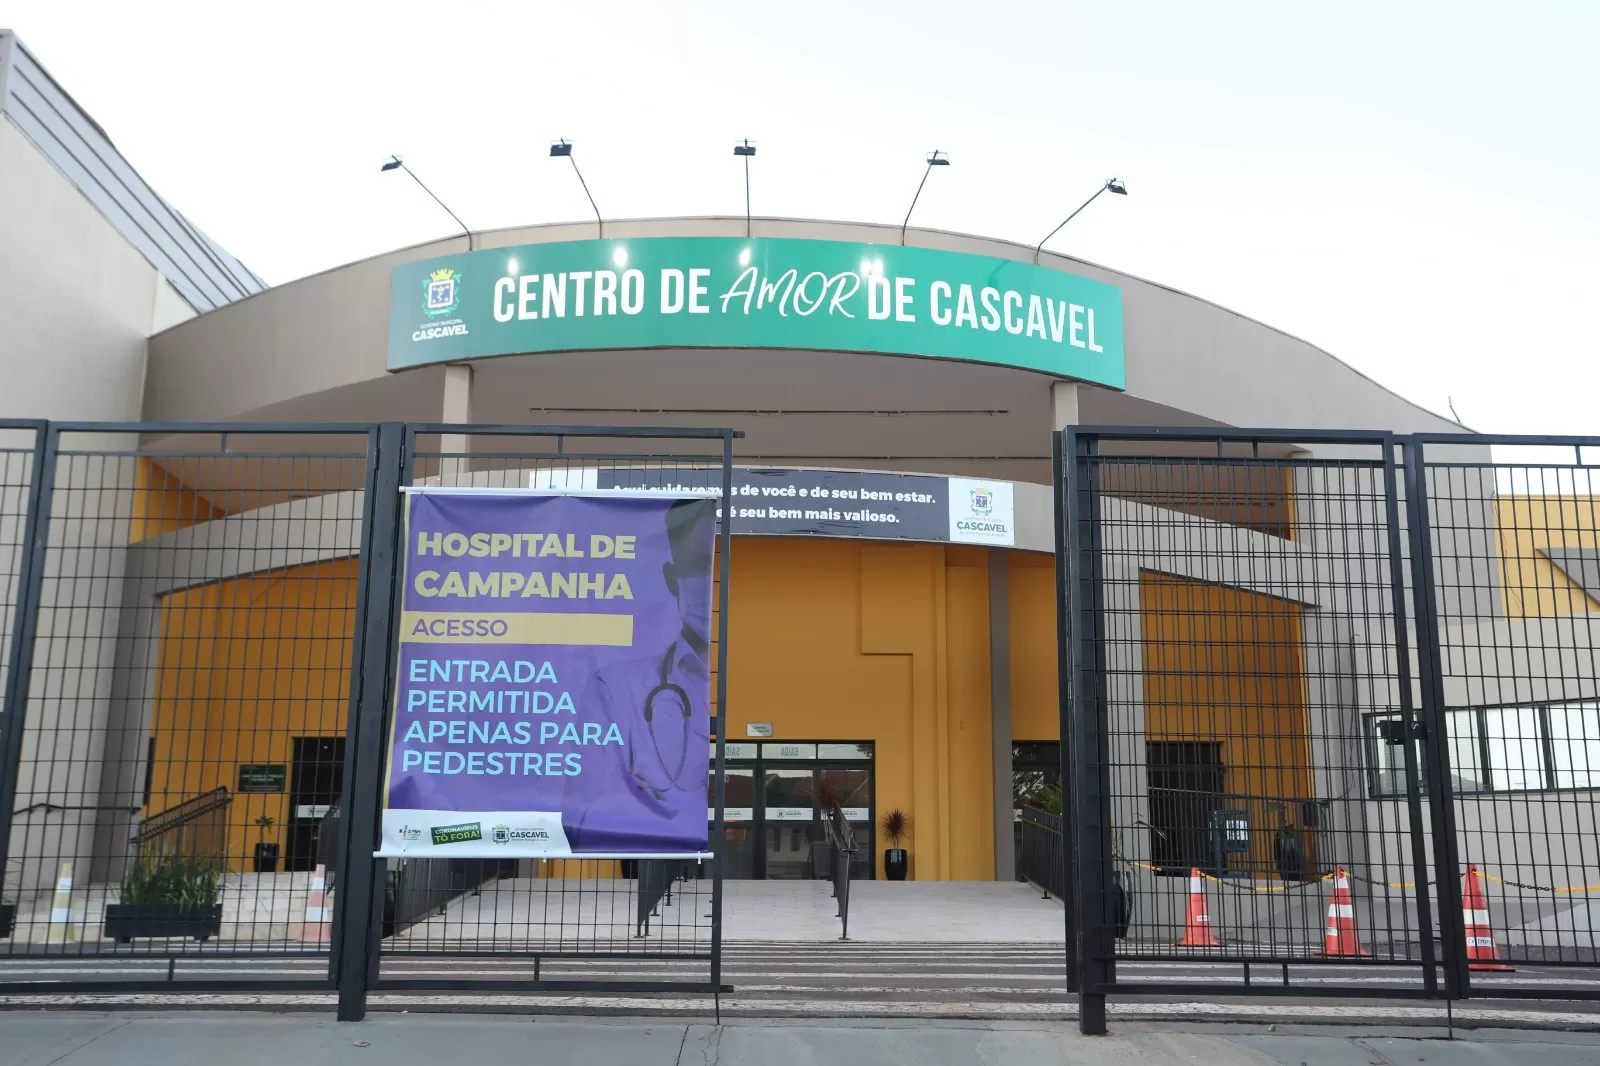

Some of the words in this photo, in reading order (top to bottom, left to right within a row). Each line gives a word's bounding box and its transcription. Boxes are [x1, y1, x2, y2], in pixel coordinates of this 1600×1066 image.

[493, 269, 645, 323] CENTRO
[660, 268, 711, 314] DE
[867, 275, 916, 323] DE
[930, 280, 1104, 353] CASCAVEL
[412, 324, 469, 341] CASCAVEL
[740, 485, 759, 496] de
[761, 485, 797, 497] você
[799, 488, 808, 497] e
[810, 486, 829, 498] de
[831, 489, 857, 500] seu
[860, 488, 893, 501] bem
[895, 491, 936, 504] estar.
[739, 508, 766, 518] seu
[769, 507, 802, 519] bem
[805, 508, 841, 520] mais
[843, 509, 900, 523] valioso.
[956, 521, 1008, 533] CASCAVEL
[417, 531, 584, 559] HOSPITAL
[590, 535, 636, 559] DE
[414, 569, 634, 600] CAMPANHA
[411, 618, 508, 637] ACESSO
[409, 659, 558, 684] ENTRADA
[407, 690, 577, 714] PERMITIDA
[403, 720, 532, 745] APENAS
[539, 722, 625, 746] PARA
[402, 750, 582, 776] PEDESTRES
[450, 830, 481, 841] FORA!
[510, 831, 549, 839] CASCAVEL
